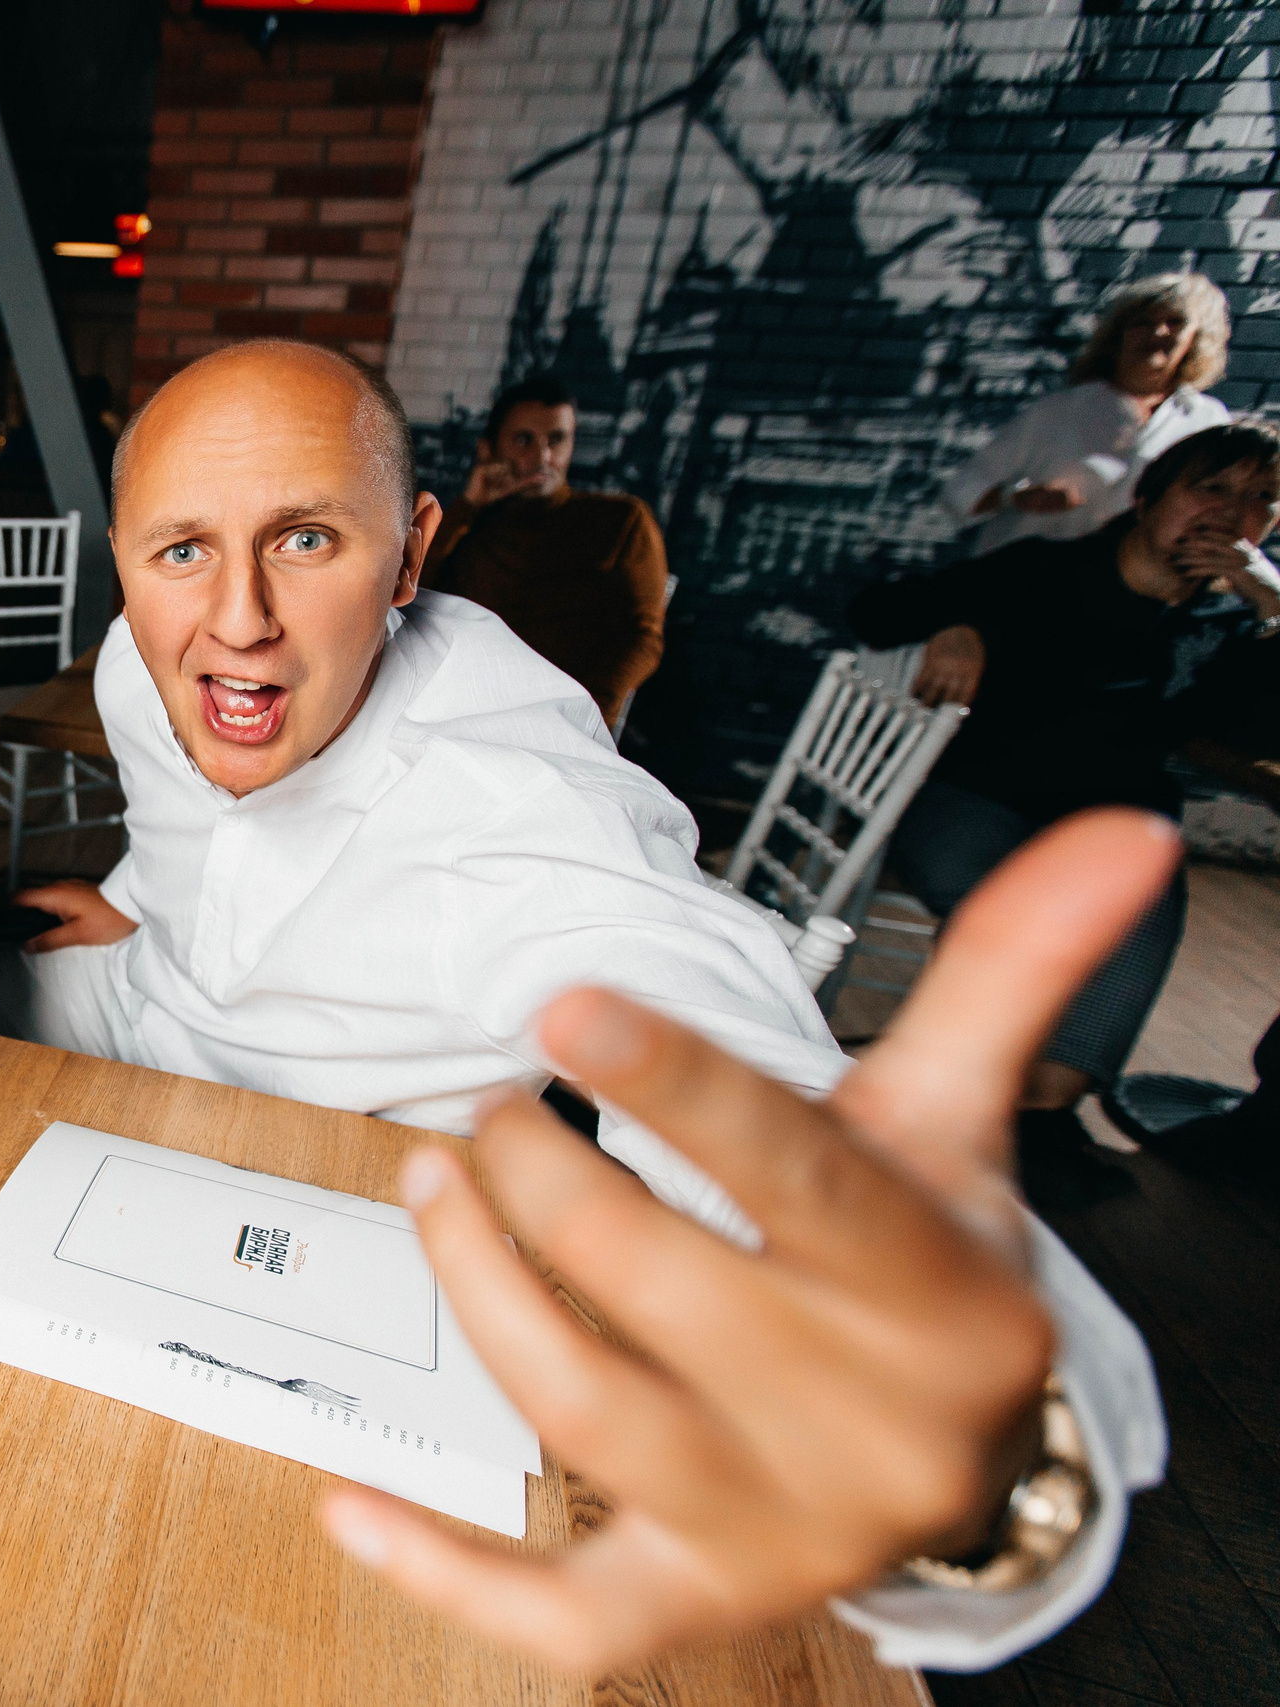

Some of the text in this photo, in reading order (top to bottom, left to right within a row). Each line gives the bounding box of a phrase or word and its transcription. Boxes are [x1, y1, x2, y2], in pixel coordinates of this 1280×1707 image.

[244, 1226, 270, 1262] БИРЖА
[264, 1228, 290, 1275] СОЛЯНАЯ
[222, 1373, 232, 1388] 650
[310, 1401, 320, 1416] 540
[326, 1406, 336, 1421] 420
[343, 1411, 352, 1426] 430
[359, 1418, 368, 1432] 510
[382, 1424, 391, 1439] 820
[399, 1429, 408, 1445] 560
